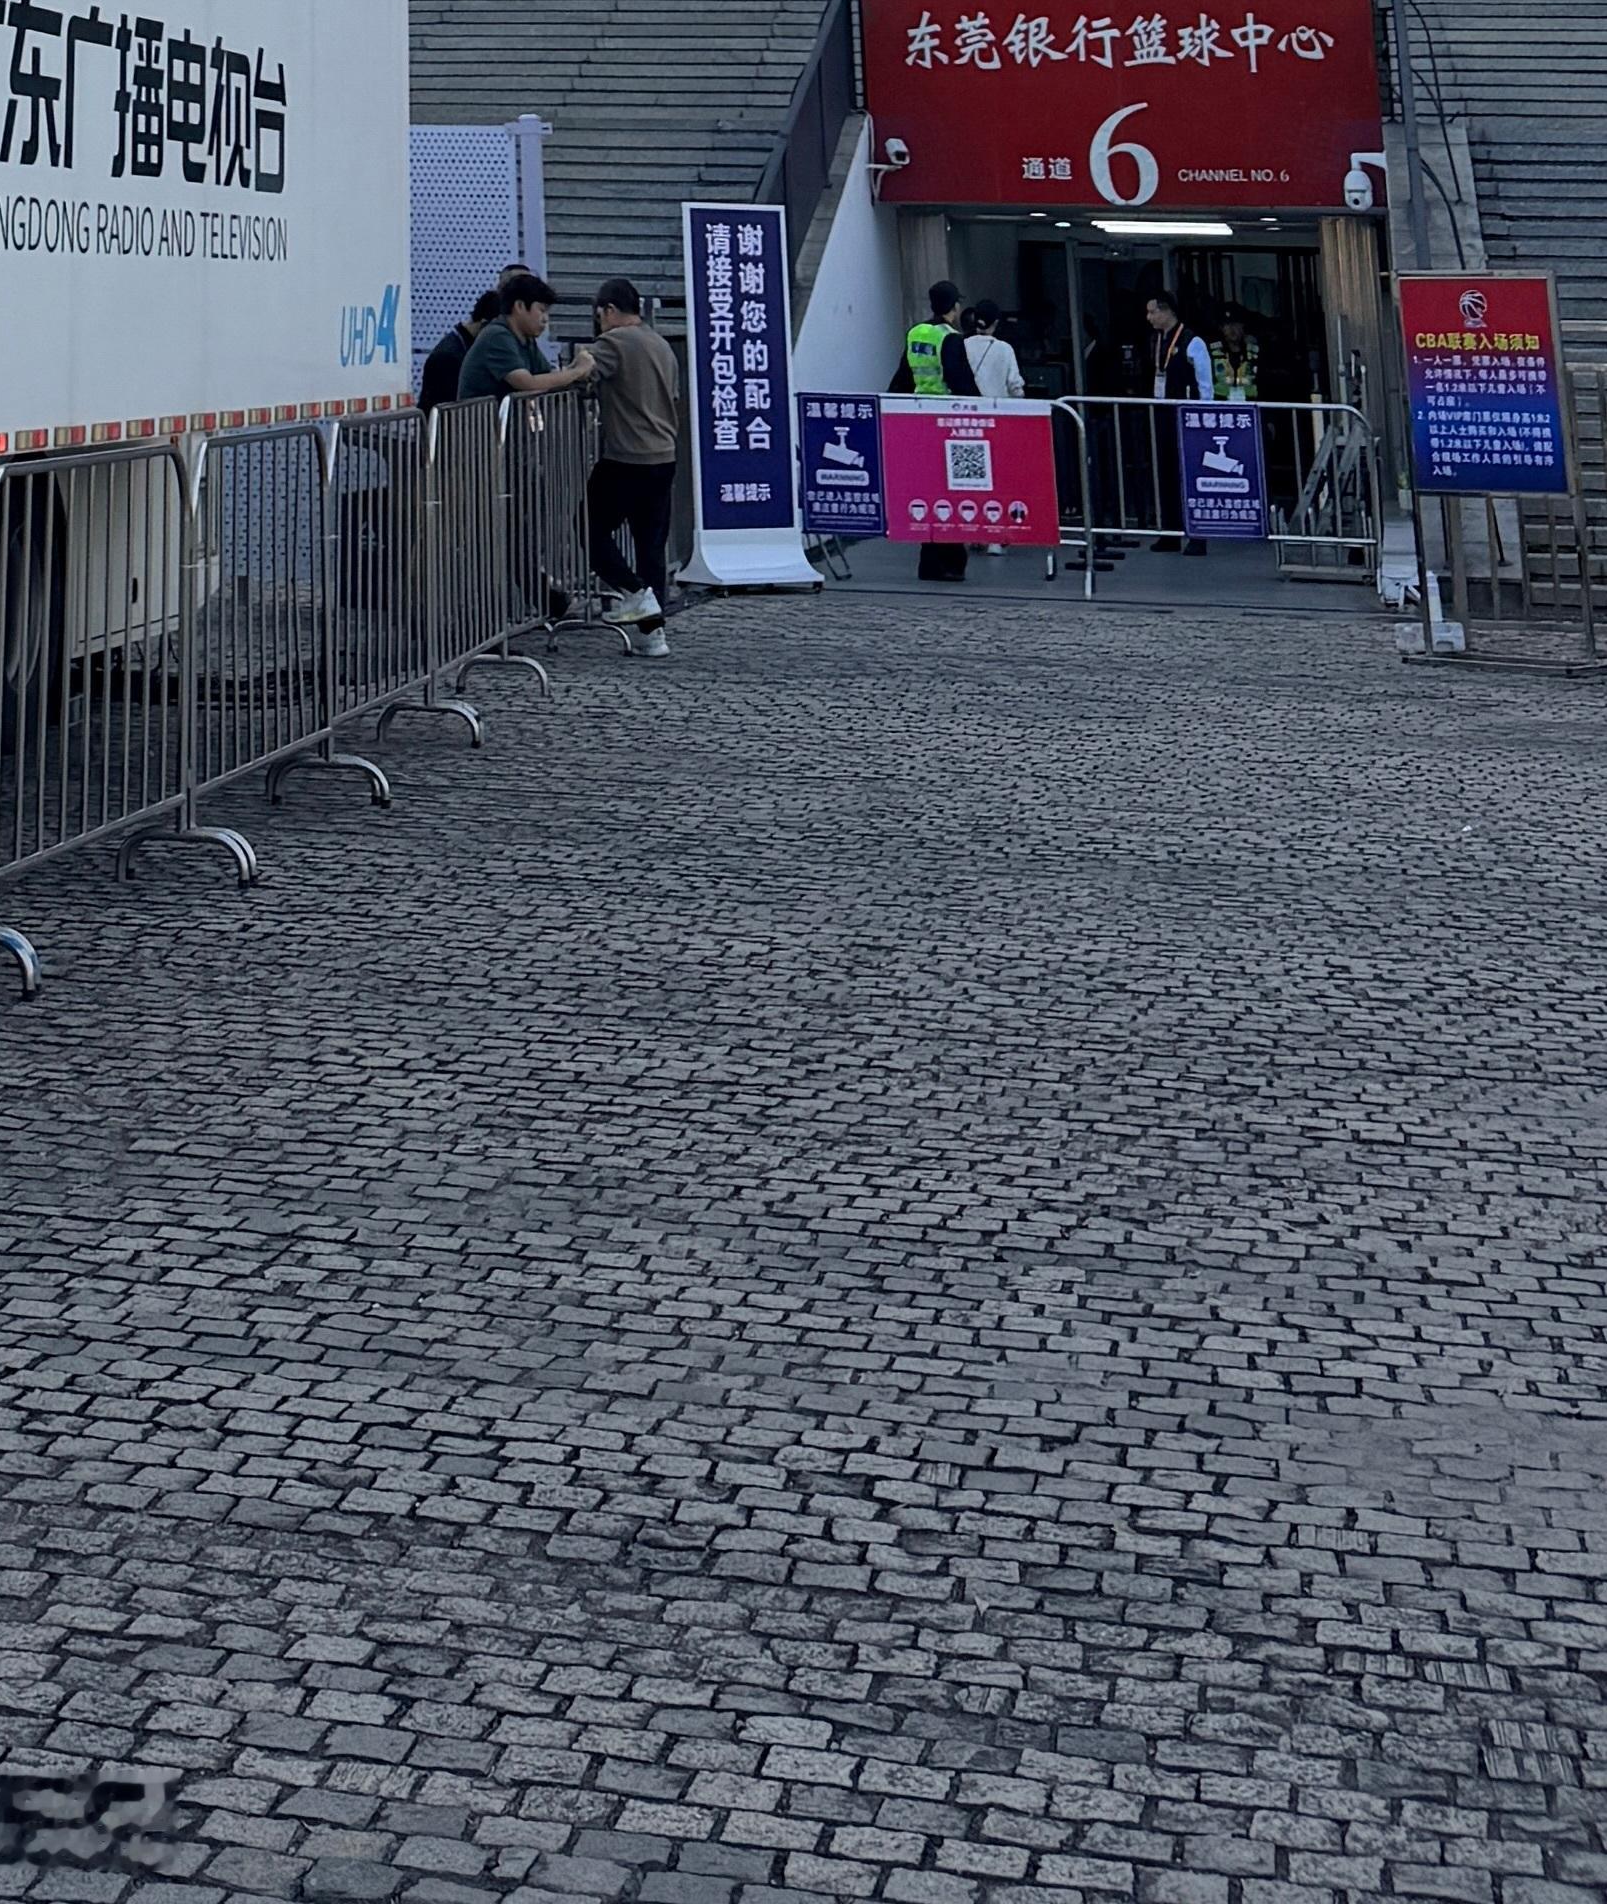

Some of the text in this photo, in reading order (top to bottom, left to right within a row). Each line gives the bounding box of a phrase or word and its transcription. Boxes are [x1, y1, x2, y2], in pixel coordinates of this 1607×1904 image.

[905, 11, 1335, 73] 东莞银行篮球中心
[1089, 102, 1160, 206] 6
[1021, 157, 1073, 180] 通道
[1177, 168, 1290, 182] CHANNEL NO. 6
[96, 203, 155, 257] RADIO
[157, 209, 196, 258] AND
[200, 211, 288, 261] TELEVISION
[705, 223, 740, 451] 请接受开包检查
[736, 224, 772, 451] 谢谢您的配合
[1415, 332, 1540, 351] CBA联赛入场须知
[806, 402, 874, 420] 温馨提示
[1185, 412, 1253, 429] 温馨提示
[720, 483, 771, 502] 温馨提示
